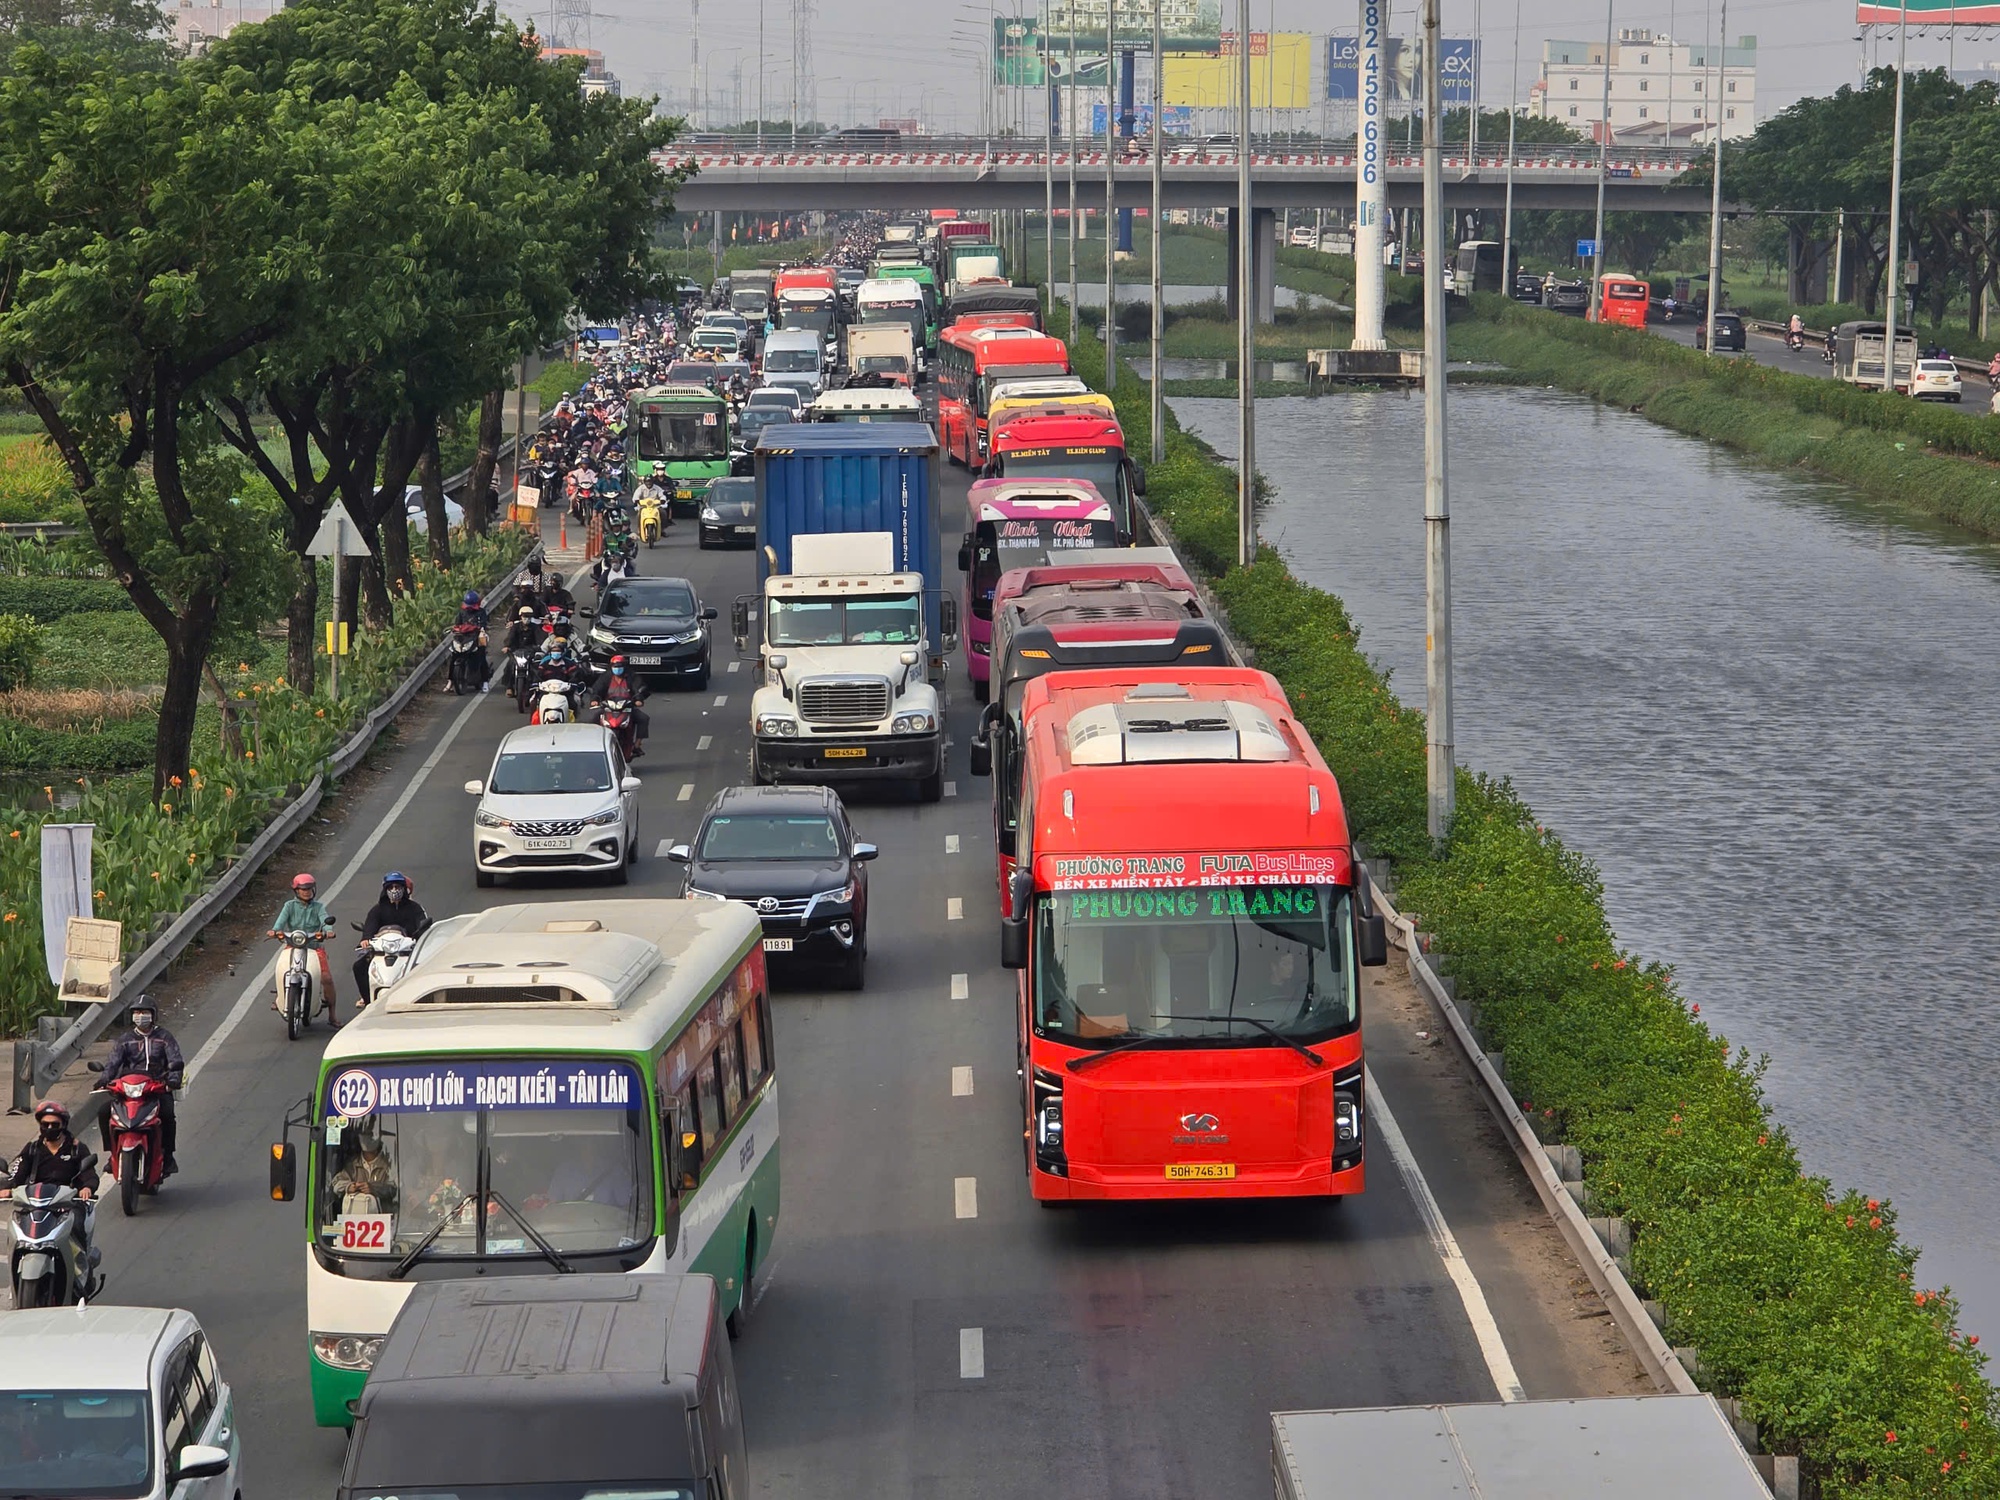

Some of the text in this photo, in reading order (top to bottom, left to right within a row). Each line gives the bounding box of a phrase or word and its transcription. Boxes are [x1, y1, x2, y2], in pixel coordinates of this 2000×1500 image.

[704, 413, 716, 425] 101
[1089, 447, 1107, 455] GIANG
[999, 520, 1040, 538] Minh
[1056, 854, 1335, 876] PHƯƠNG TRANG FUTA Bus Lines
[1054, 876, 1083, 890] BẾN
[1086, 879, 1108, 889] XE
[1111, 874, 1149, 889] MIỀN
[1153, 876, 1186, 888] TÂY
[1200, 872, 1231, 886] BẾN
[1235, 875, 1256, 886] XE
[1259, 872, 1302, 885] CHÂU
[1304, 870, 1336, 885] ĐỐC
[1071, 888, 1316, 918] PHƯƠNG TRANG
[339, 1078, 369, 1109] 622
[380, 1078, 400, 1107] BX
[402, 1073, 435, 1112] CHỢ
[437, 1070, 465, 1106] LỚN
[476, 1075, 517, 1109] RẠCH
[520, 1067, 556, 1104] KIẾN
[568, 1069, 598, 1104] TÂN
[601, 1069, 629, 1104] LÂN
[1170, 1165, 1230, 1177] 50H-746.31
[342, 1220, 386, 1249] 622
